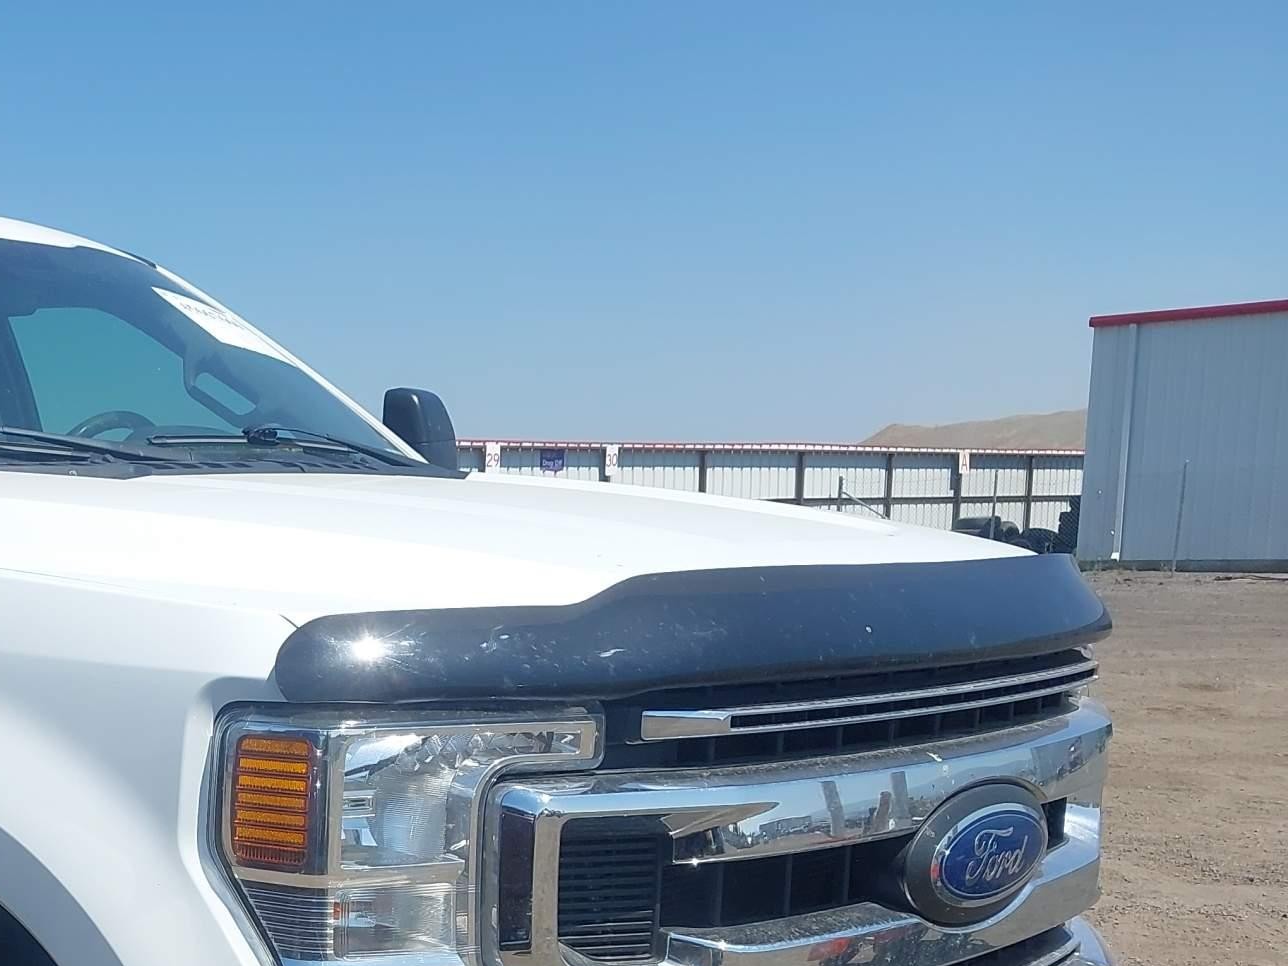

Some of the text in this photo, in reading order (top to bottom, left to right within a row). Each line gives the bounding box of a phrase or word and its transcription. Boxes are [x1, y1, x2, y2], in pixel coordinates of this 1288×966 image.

[486, 453, 500, 468] 29
[605, 453, 618, 467] 30
[961, 454, 968, 470] A
[965, 826, 1028, 888] Ford
